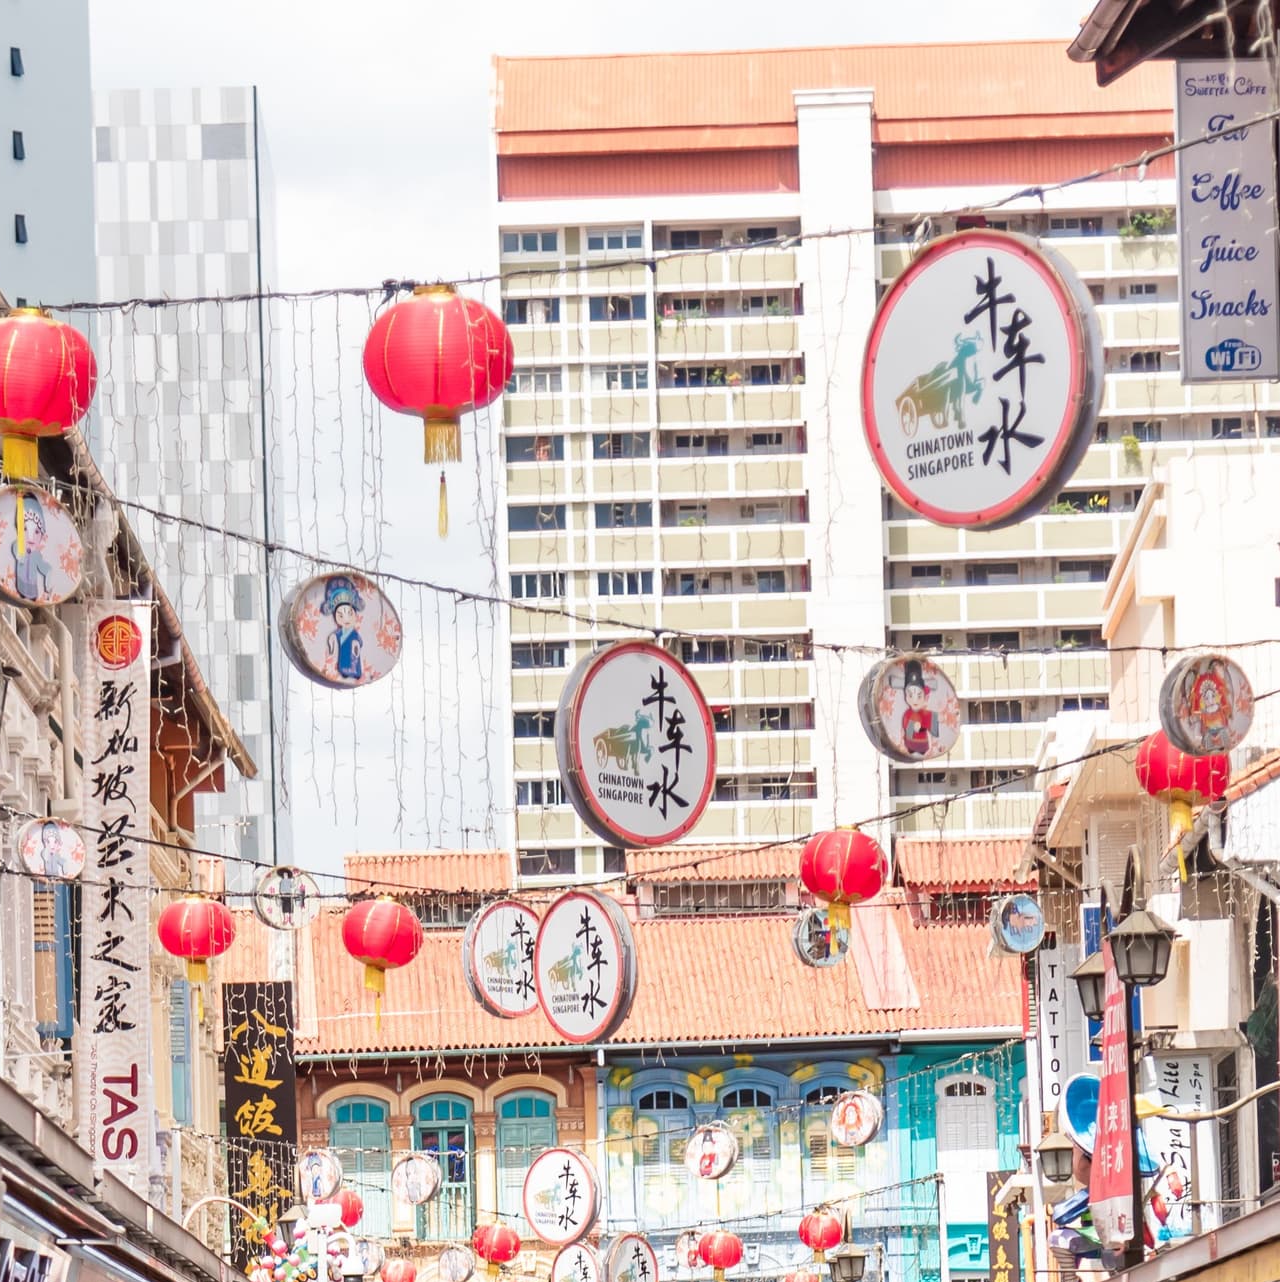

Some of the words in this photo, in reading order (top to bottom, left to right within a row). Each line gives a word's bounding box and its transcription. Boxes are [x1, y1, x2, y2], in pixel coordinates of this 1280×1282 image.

[1190, 168, 1265, 211] Coffee
[1199, 235, 1259, 273] Juice
[1190, 289, 1271, 320] Snacks
[964, 256, 1046, 476] 牛车水
[906, 430, 974, 460] CHINATOWN
[907, 451, 975, 480] SINGAPORE
[642, 665, 693, 821] 牛车水
[598, 772, 645, 790] CHINATOWN
[598, 787, 644, 805] SINGAPORE
[576, 905, 609, 1020] 牛车水
[551, 994, 580, 1003] CHINATOWN
[552, 1004, 580, 1015] SINGAPORE
[1047, 964, 1061, 1096] TATTOO
[1158, 1061, 1181, 1099] Lite
[1189, 1063, 1204, 1091] Spa
[101, 1063, 139, 1161] TAS
[1160, 1128, 1191, 1170] Spa
[558, 1159, 581, 1232] 牛车水
